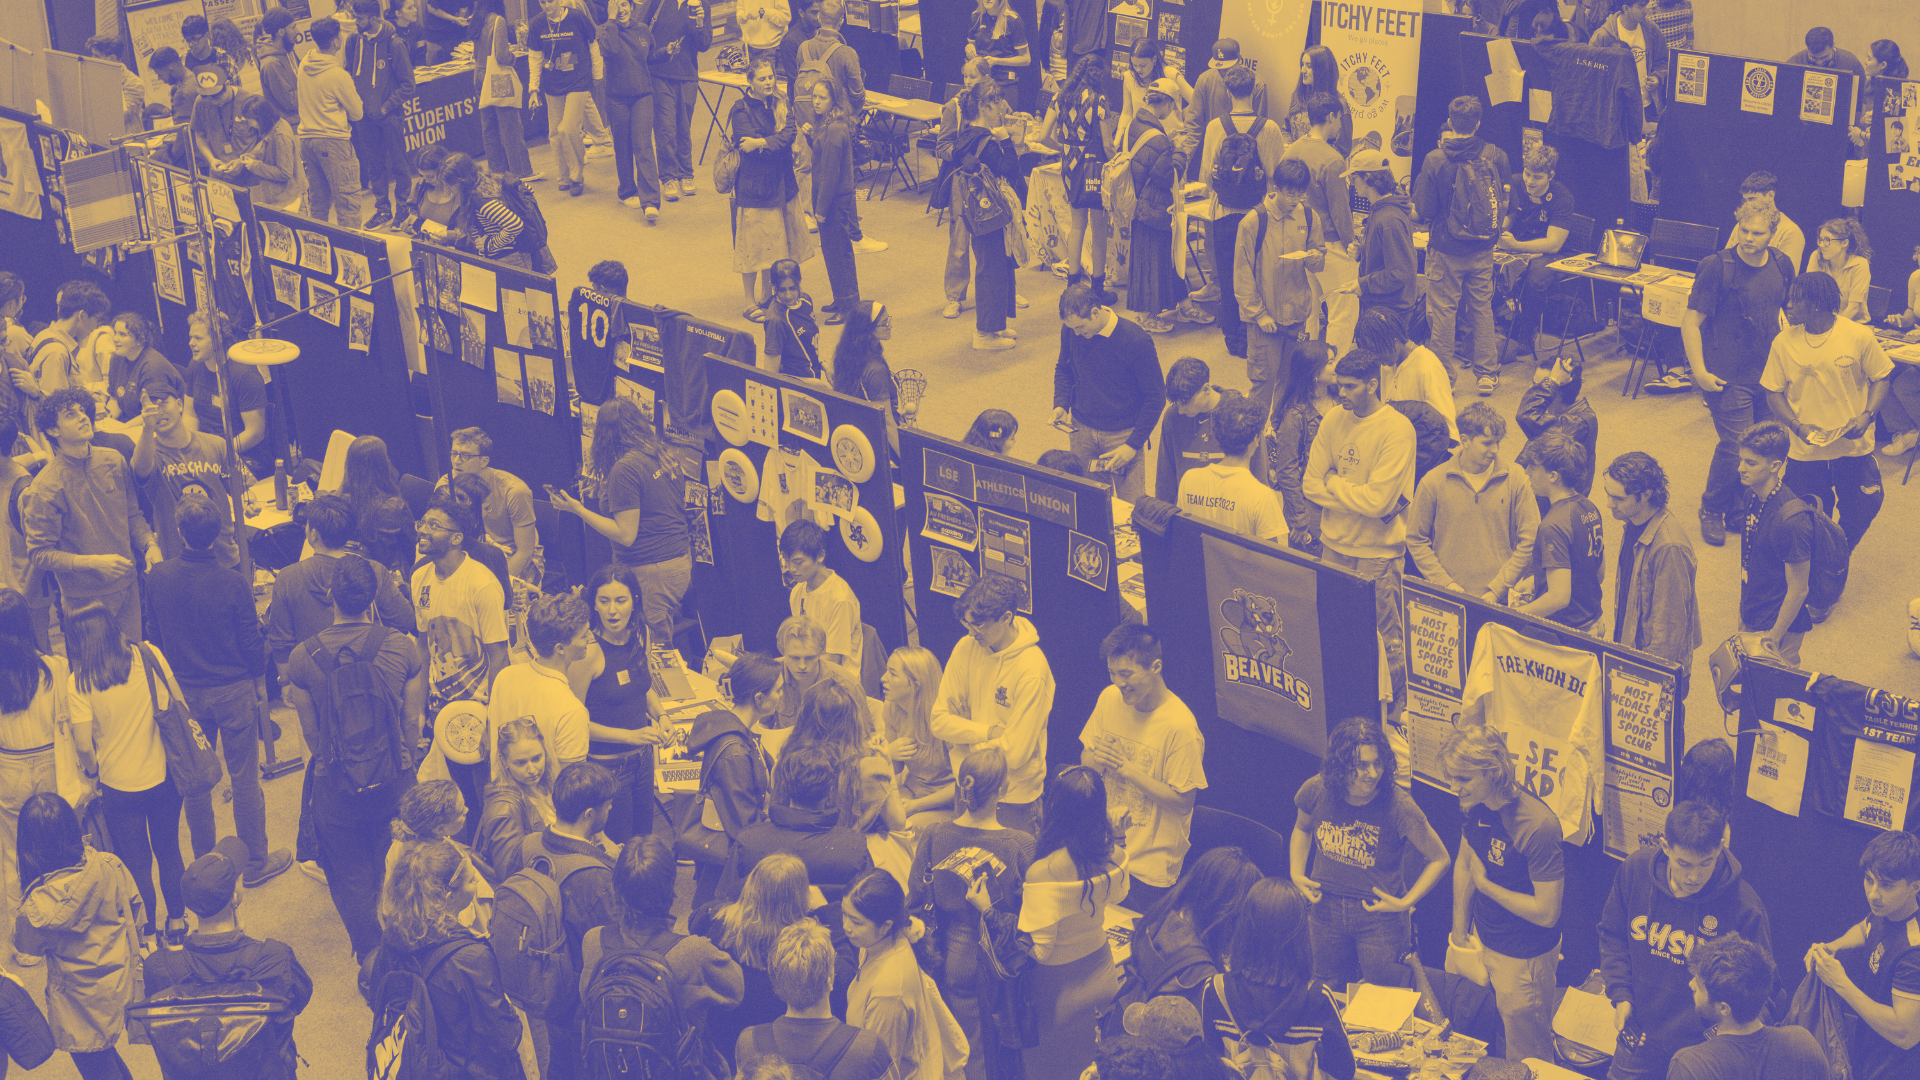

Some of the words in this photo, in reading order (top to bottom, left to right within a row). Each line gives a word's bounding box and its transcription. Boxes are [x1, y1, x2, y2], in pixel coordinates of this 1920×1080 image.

[1323, 0, 1373, 32] ITCHY
[1376, 7, 1420, 38] FEET
[1348, 34, 1358, 42] We
[1369, 38, 1388, 46] places
[1340, 52, 1368, 71] ITCHY
[1370, 55, 1391, 78] FEET
[402, 96, 422, 117] SE
[403, 96, 477, 135] TUDENTS'
[179, 206, 197, 217] BASKE
[579, 287, 610, 308] POGGIO
[578, 302, 610, 348] 10
[694, 326, 726, 343] VOLLEYBALL
[939, 465, 959, 483] LSE
[975, 479, 1025, 499] ATHLETICS
[1029, 491, 1070, 515] UNION
[1186, 493, 1204, 506] TEAM
[1410, 624, 1446, 643] MEDALS
[1421, 615, 1448, 632] MOST
[1416, 637, 1435, 651] ANY
[1437, 645, 1454, 658] LSE
[1417, 649, 1454, 669] SPORTS
[1423, 663, 1449, 679] CLUB
[1222, 652, 1312, 711] BEAVERS
[1610, 693, 1651, 715] MEDALS
[1624, 685, 1654, 703] MOST
[1617, 708, 1638, 722] ANY
[1640, 716, 1659, 731] LSE
[1863, 714, 1889, 727] TABLE
[1889, 720, 1919, 731] TENNIS
[1618, 719, 1659, 742] SPORTS
[1862, 726, 1884, 739] 1ST
[1885, 731, 1917, 745] TEAM
[1625, 734, 1653, 751] CLUB
[1650, 948, 1671, 960] SINCE
[1574, 999, 1618, 1026] KIC
